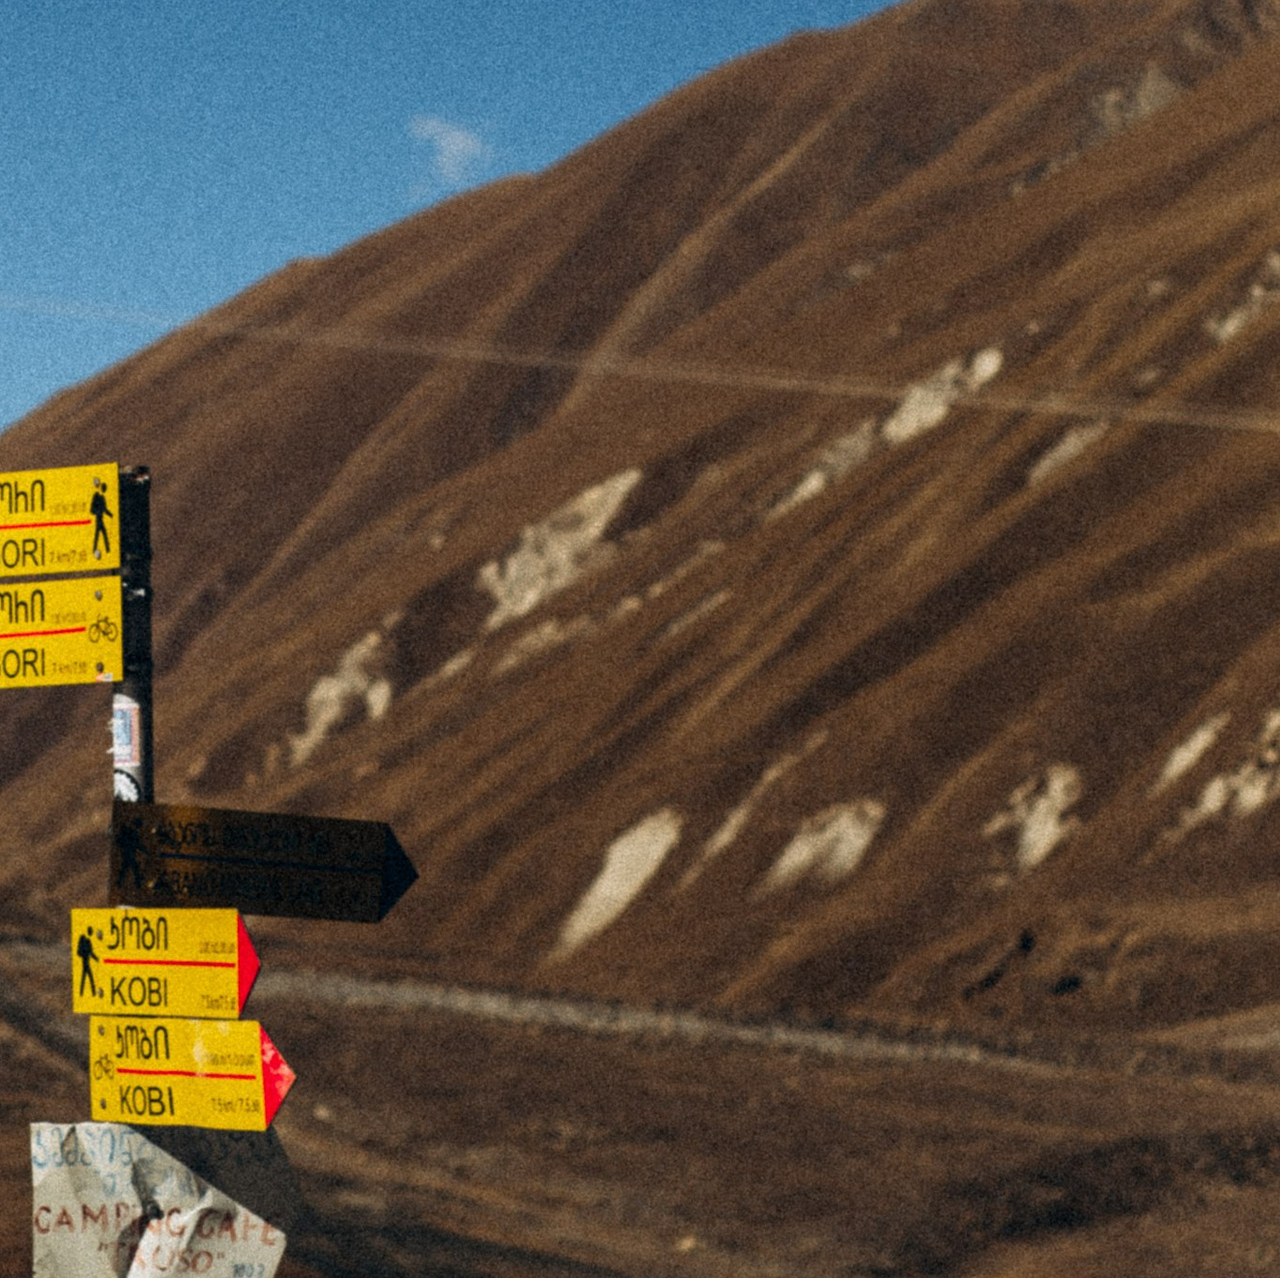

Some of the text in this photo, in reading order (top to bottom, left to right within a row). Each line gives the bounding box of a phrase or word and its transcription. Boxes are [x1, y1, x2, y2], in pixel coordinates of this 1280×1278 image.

[107, 916, 168, 951] კობი
[110, 977, 168, 1007] KOBI
[115, 1025, 170, 1060] კობი
[119, 1085, 175, 1116] KOBI
